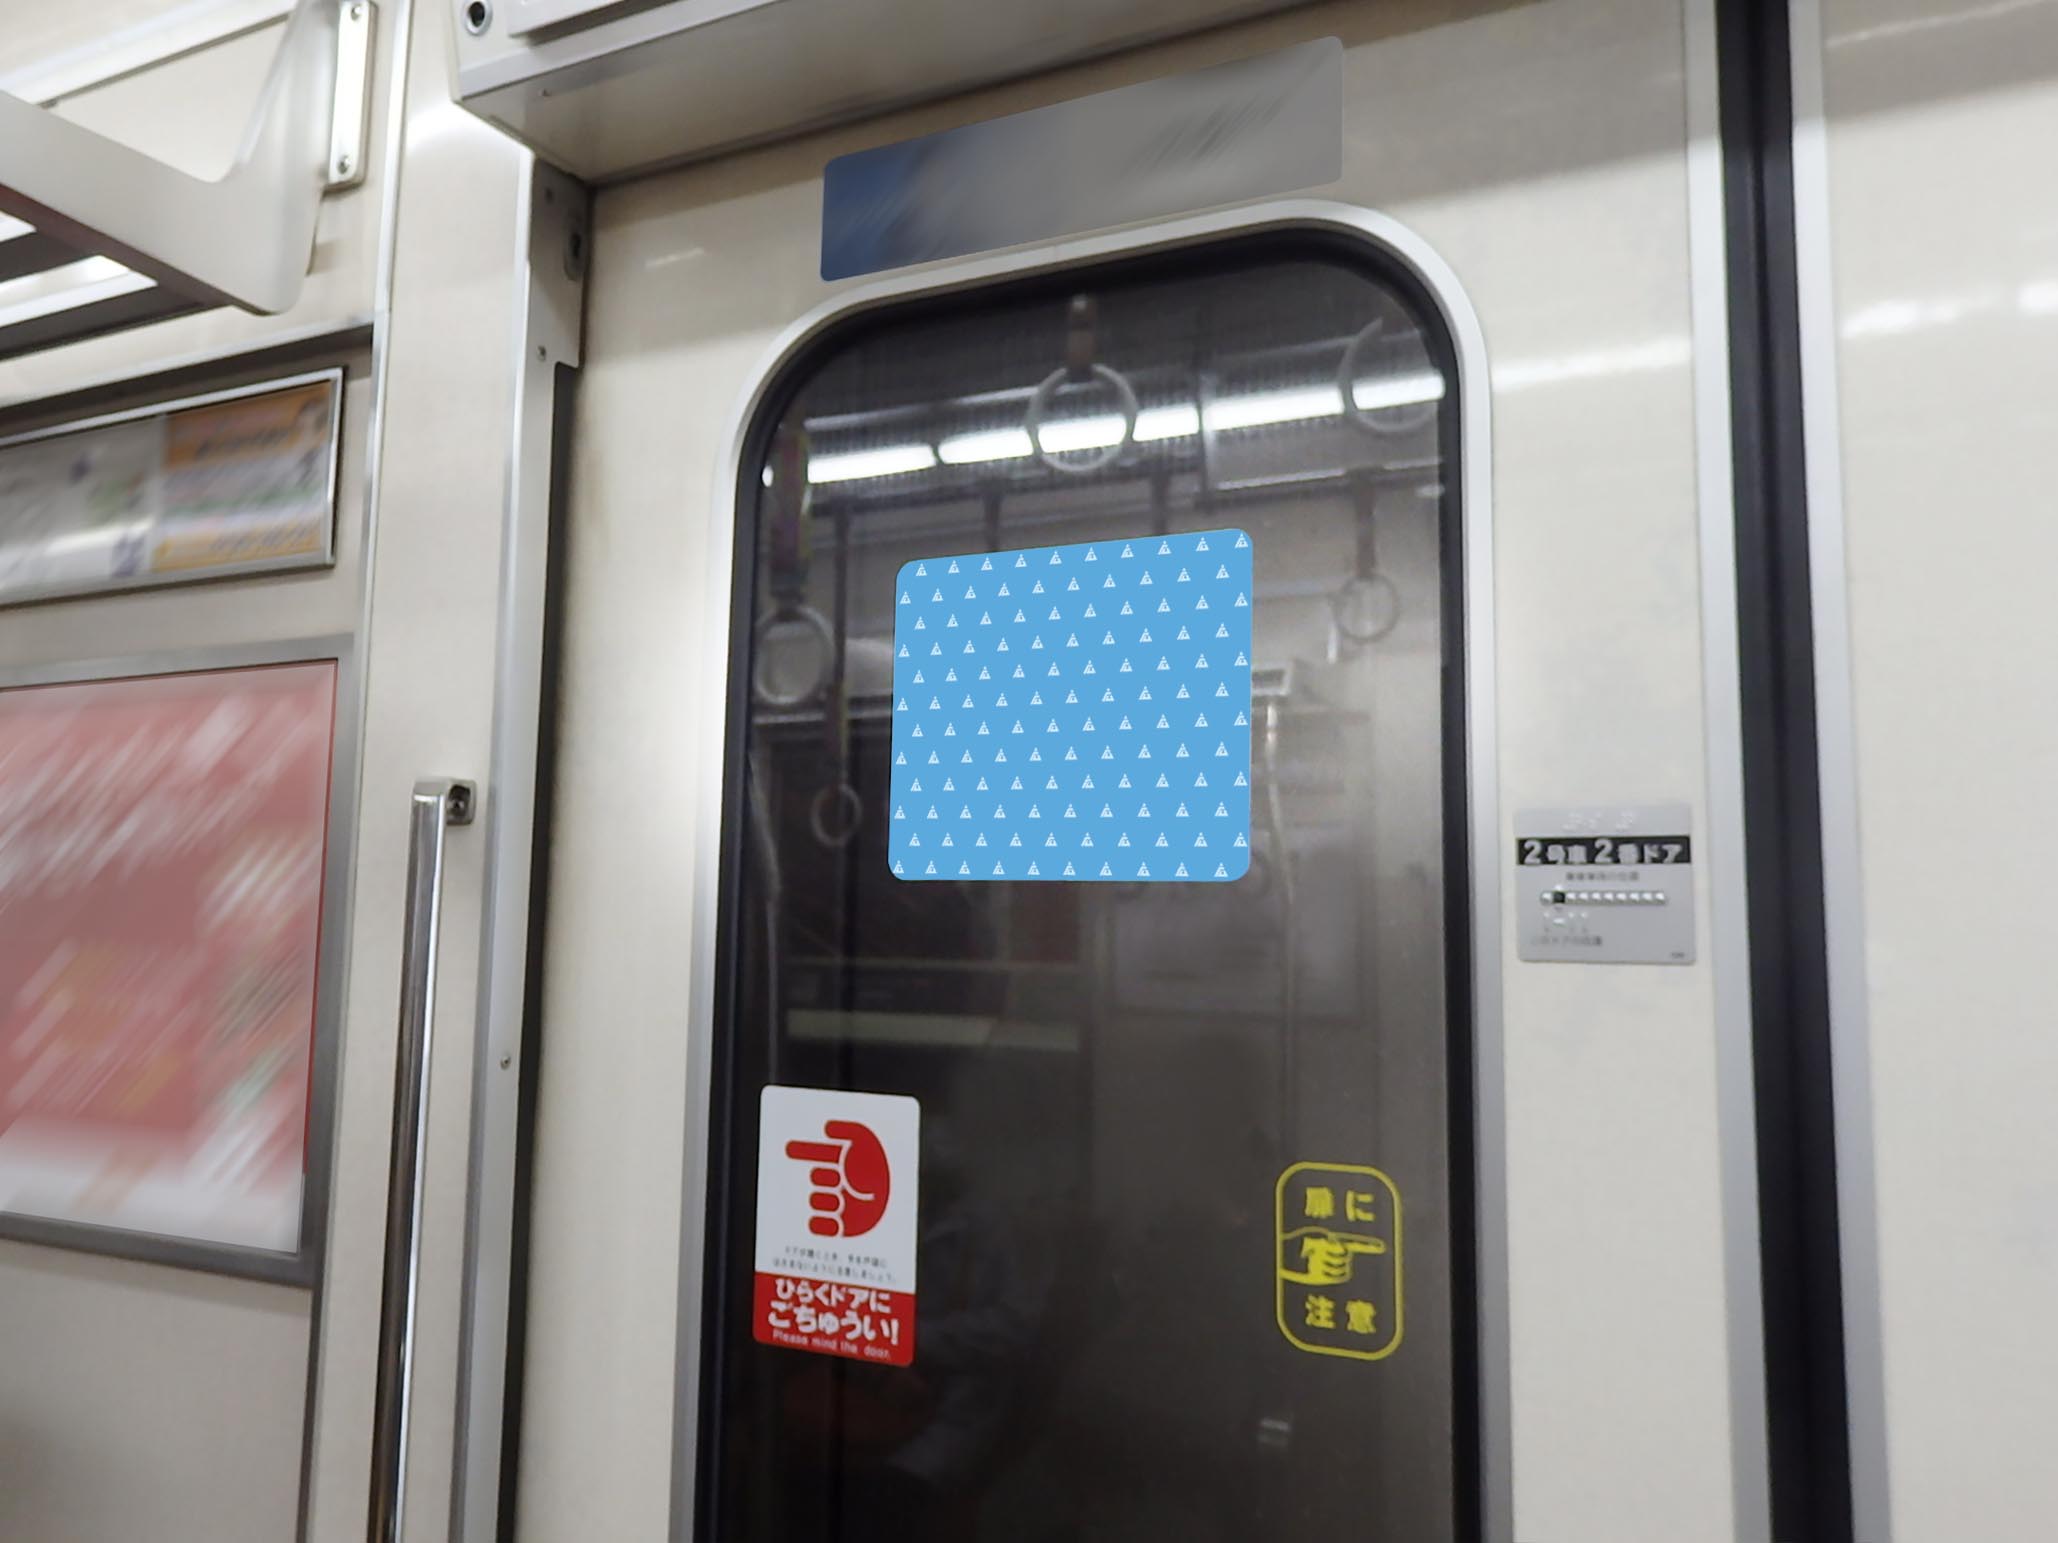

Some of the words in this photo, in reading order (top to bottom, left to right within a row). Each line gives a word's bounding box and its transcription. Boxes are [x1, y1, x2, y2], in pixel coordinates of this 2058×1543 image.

[775, 1278, 891, 1314] ひらくドアに
[1305, 1295, 1376, 1334] 注意
[767, 1300, 900, 1345] ごちゅうい!
[772, 1327, 809, 1346] Please
[811, 1337, 838, 1351] mind
[840, 1340, 859, 1355] the
